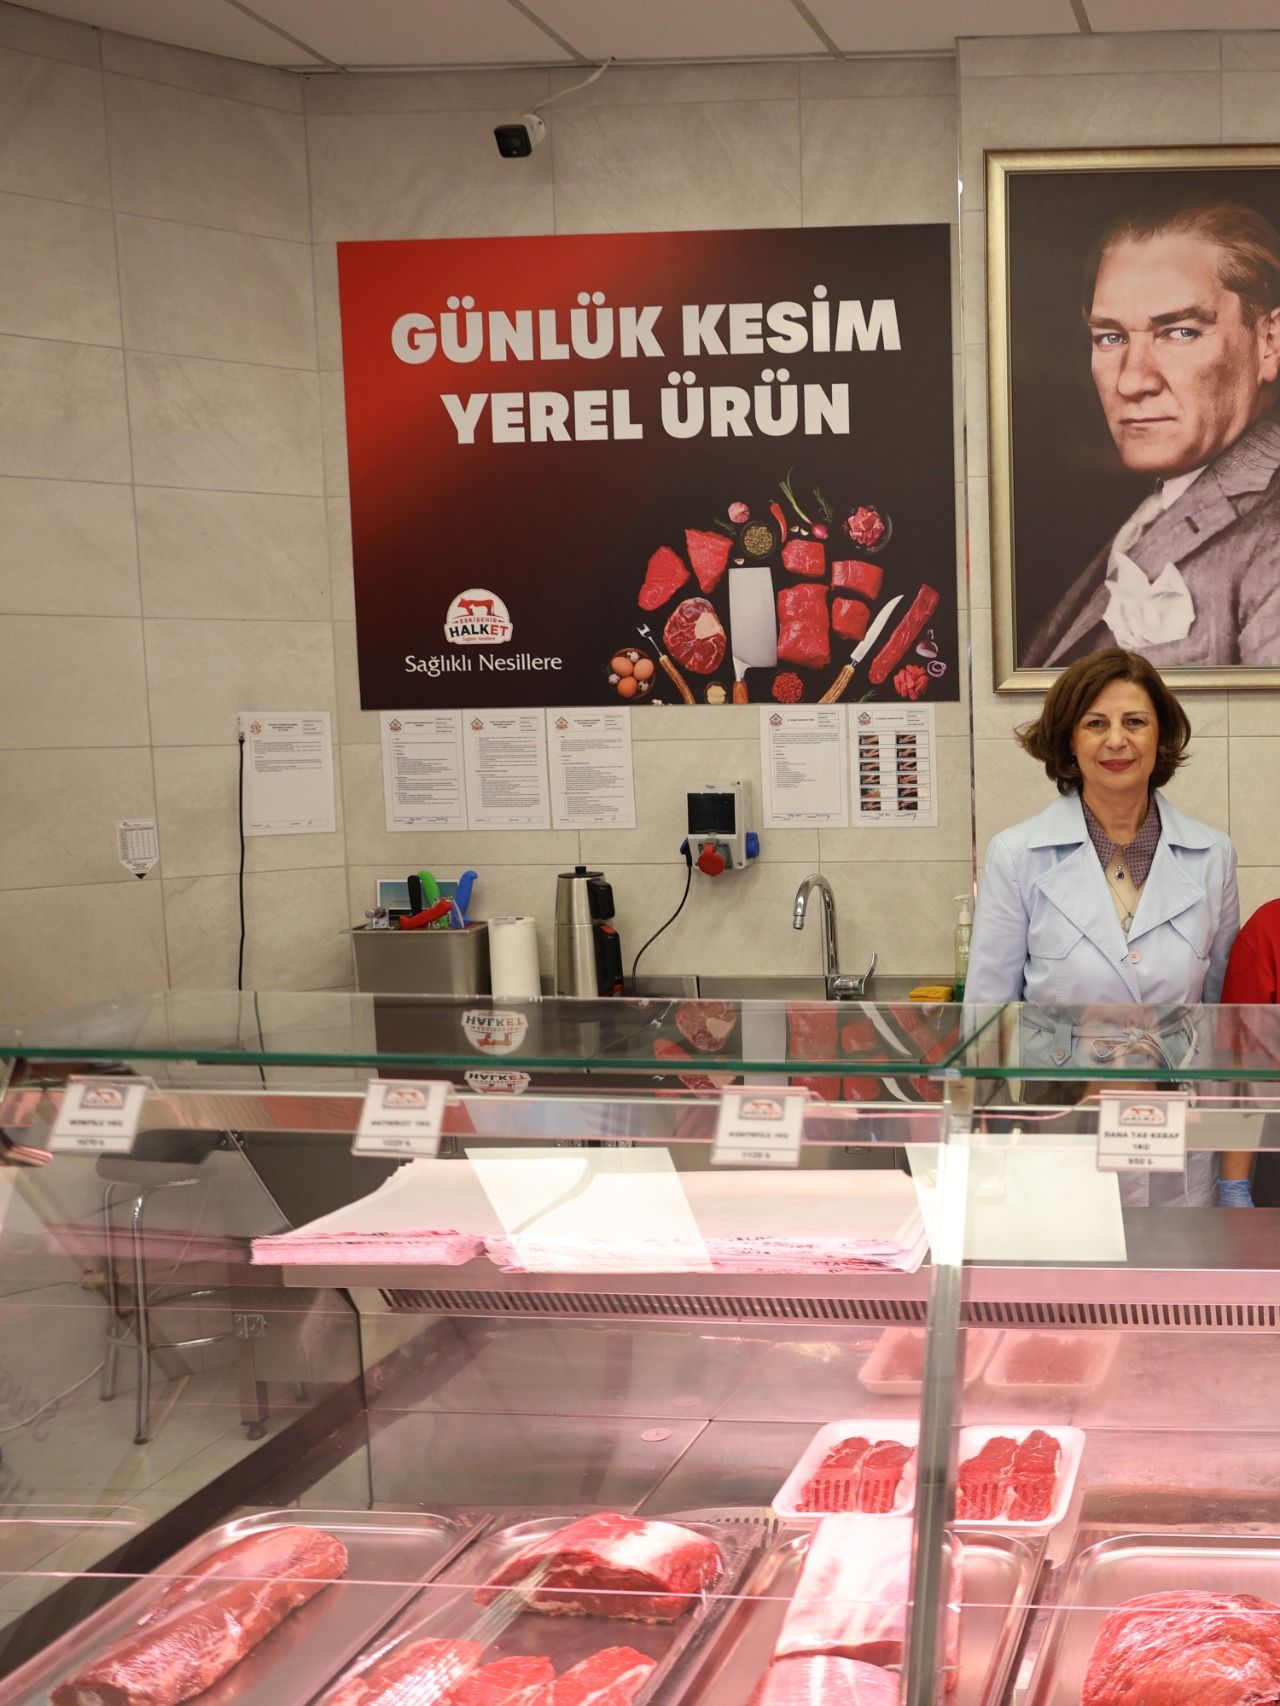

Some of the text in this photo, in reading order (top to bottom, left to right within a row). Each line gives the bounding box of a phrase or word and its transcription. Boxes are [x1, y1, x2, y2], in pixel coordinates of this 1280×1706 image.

[391, 284, 902, 365] GÜNLÜK KESİM
[439, 367, 850, 445] YEREL ÜRÜN
[448, 624, 509, 638] HALKET
[405, 653, 563, 678] Sağlıklı Nesillere
